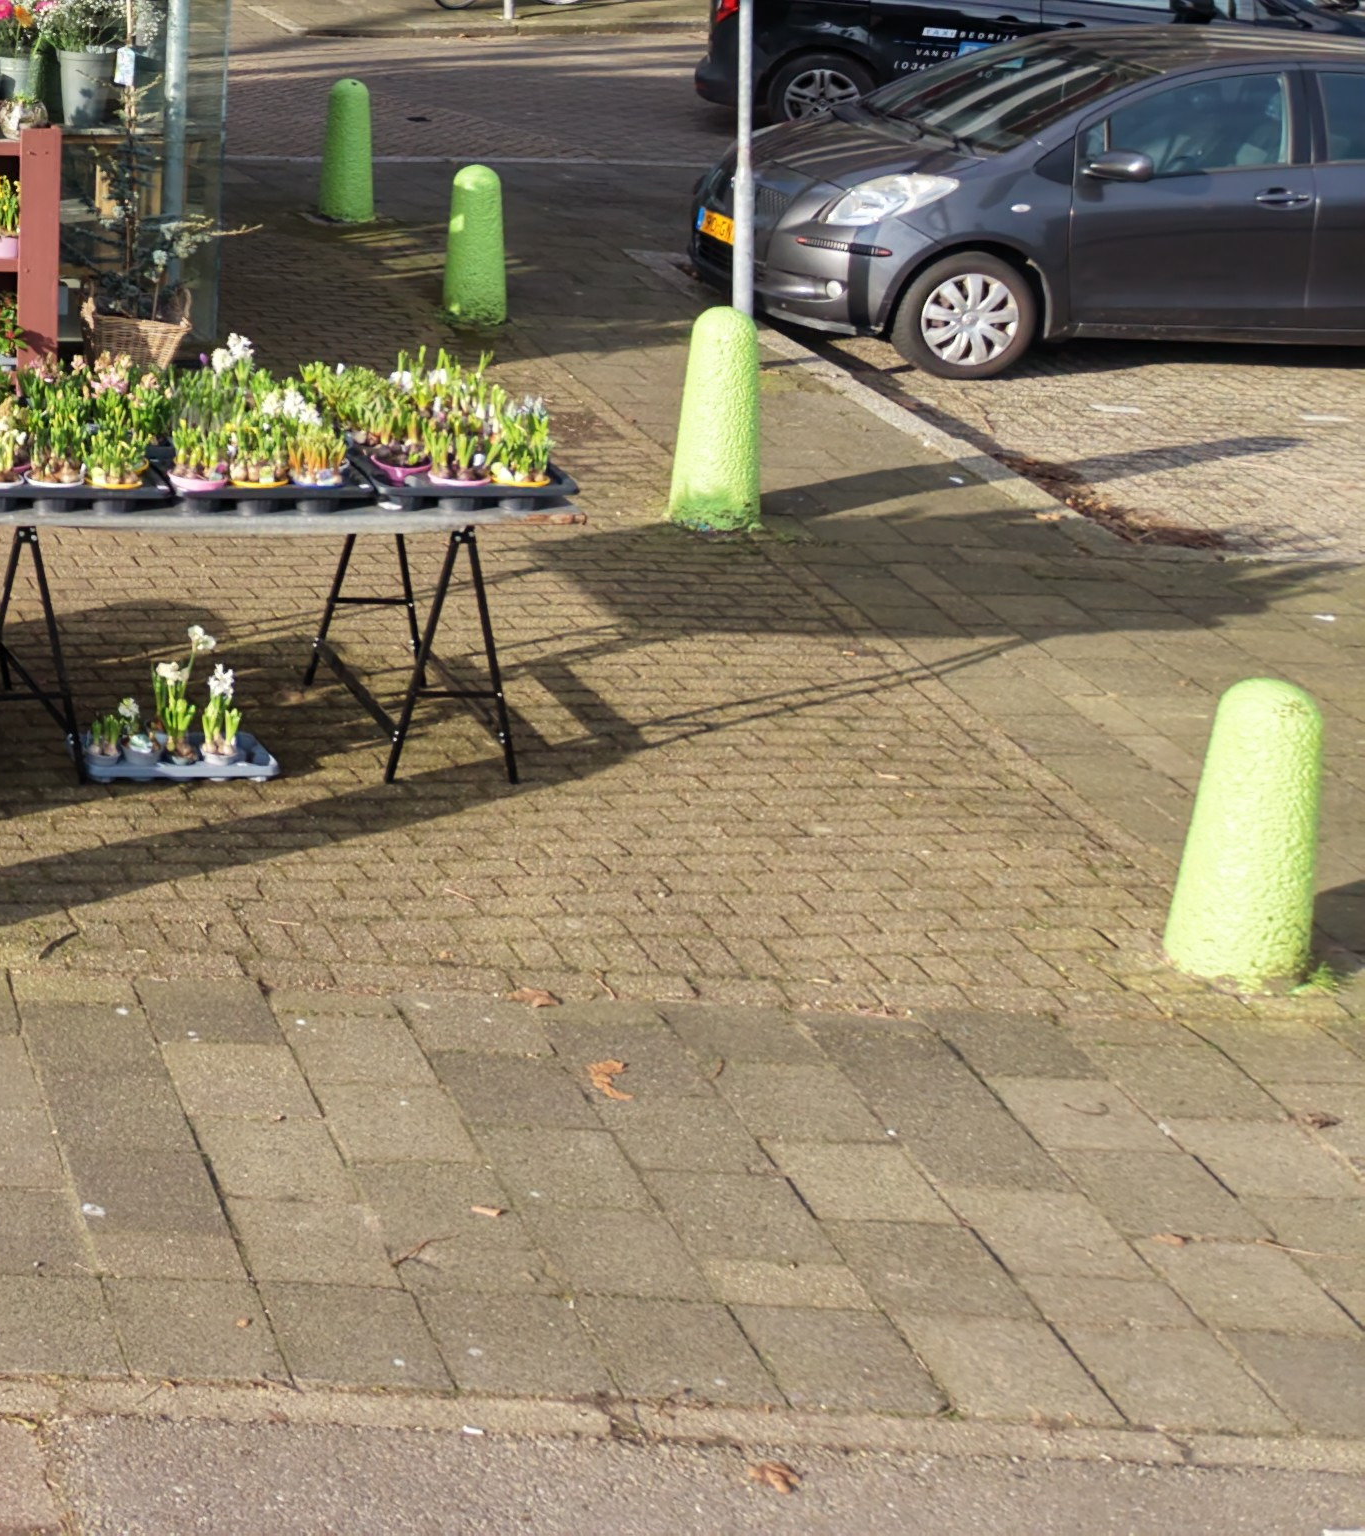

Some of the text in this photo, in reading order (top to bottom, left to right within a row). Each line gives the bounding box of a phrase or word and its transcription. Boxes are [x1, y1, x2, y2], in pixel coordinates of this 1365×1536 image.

[925, 28, 955, 37] TAXI
[916, 49, 939, 57] VAN
[894, 61, 935, 71] (034
